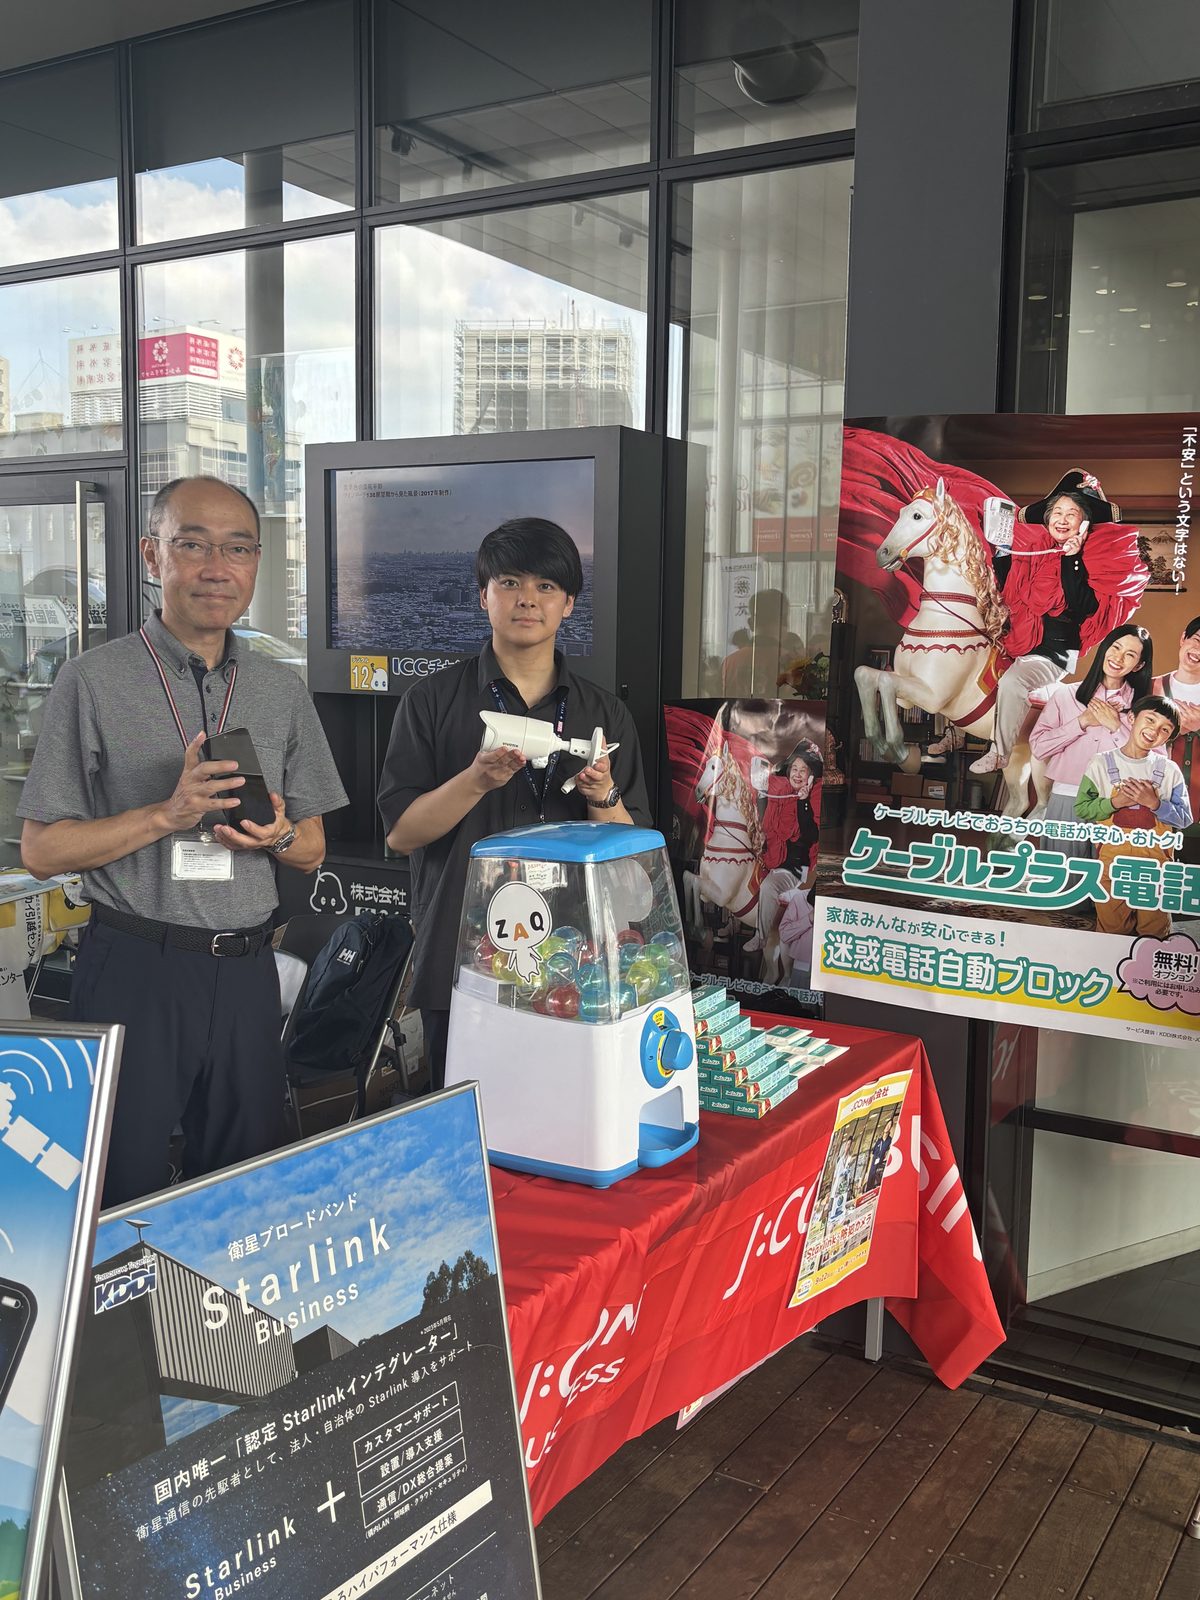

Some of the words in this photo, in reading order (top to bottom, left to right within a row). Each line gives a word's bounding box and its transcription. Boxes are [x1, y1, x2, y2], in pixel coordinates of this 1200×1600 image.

[352, 666, 369, 688] 12
[350, 882, 407, 906] 株式会社
[495, 911, 545, 941] ZAQ
[0, 972, 22, 986] ンター
[823, 931, 1113, 1008] 迷惑電話自動ブロック
[1154, 970, 1194, 983] オプション
[1155, 988, 1183, 998] 必要です。
[228, 1192, 358, 1262] 衛星ブロードバンド
[94, 1262, 158, 1315] KDDI
[202, 1217, 391, 1330] Starlink
[254, 1282, 359, 1345] Business
[368, 1378, 409, 1408] Starlink
[364, 1395, 448, 1454] カスタマーサポート
[185, 1516, 297, 1600] Starlink
[214, 1556, 277, 1600] Business
